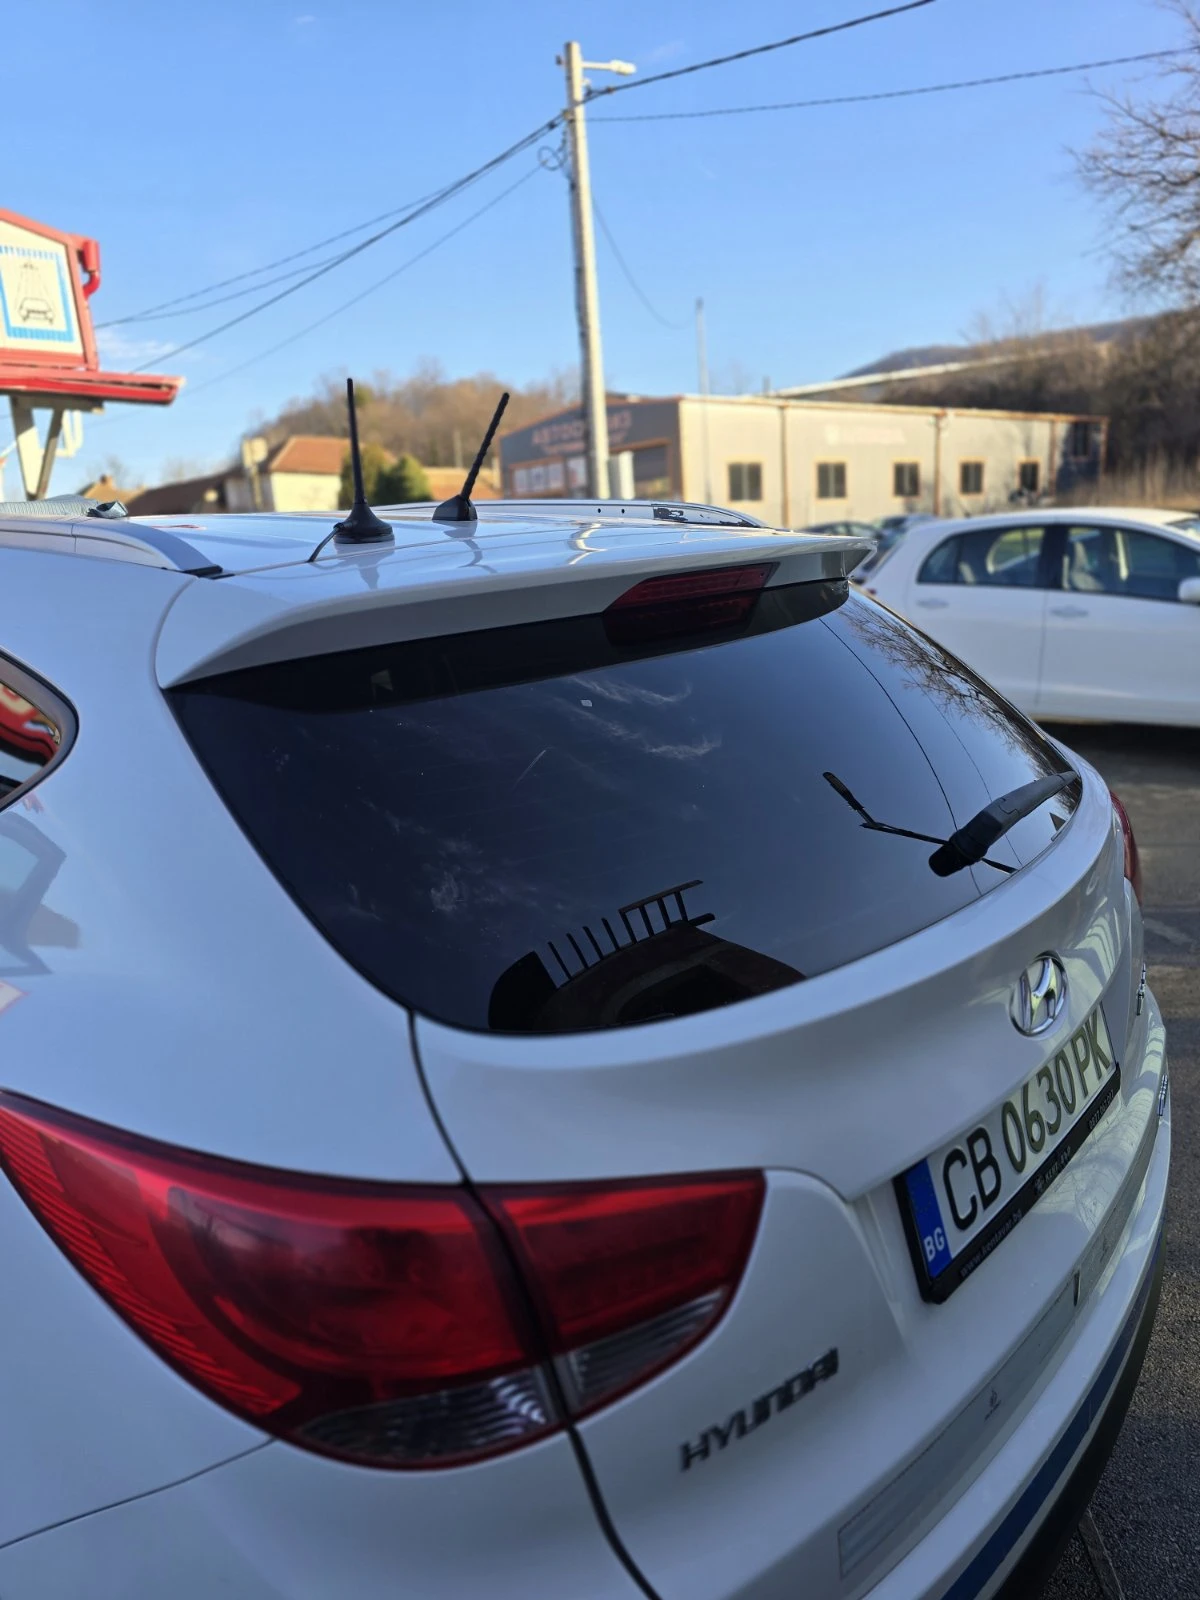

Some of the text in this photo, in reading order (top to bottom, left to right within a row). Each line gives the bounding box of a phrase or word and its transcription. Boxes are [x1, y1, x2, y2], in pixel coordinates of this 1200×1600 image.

[942, 1125, 1002, 1231] CB
[1001, 1048, 1077, 1174] 0630
[924, 1226, 946, 1262] BG
